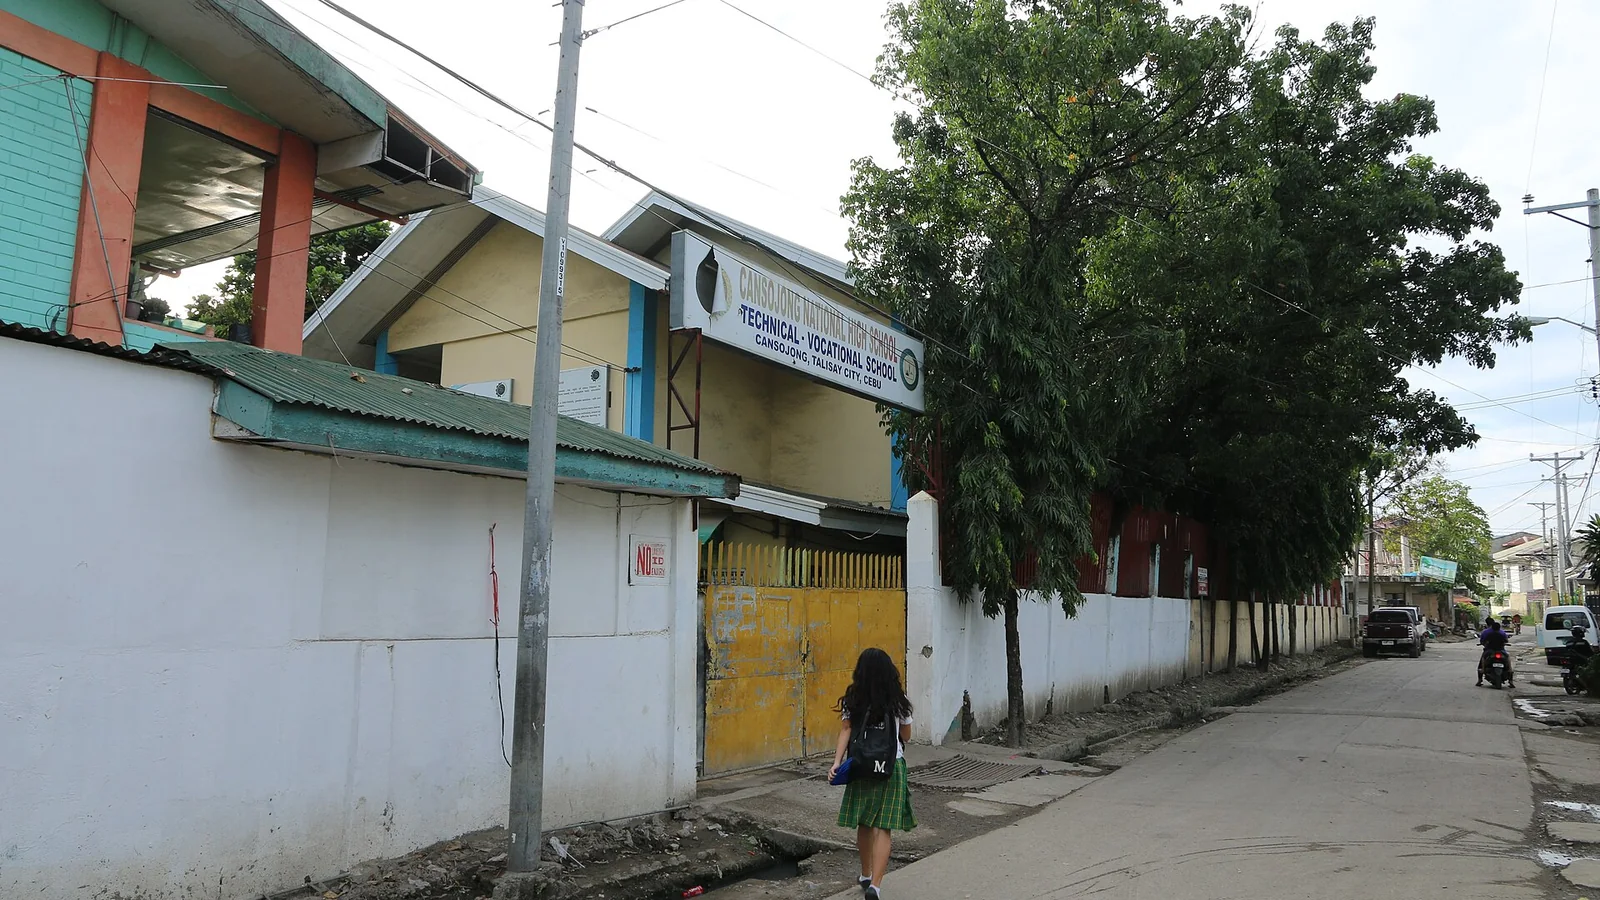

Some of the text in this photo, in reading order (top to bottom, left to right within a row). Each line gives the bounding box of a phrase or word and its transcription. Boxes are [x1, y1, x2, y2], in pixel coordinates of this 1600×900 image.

[739, 266, 898, 363] CANSOJONG NATIONAL HIGH SCHOOL
[740, 304, 800, 345] TECHNICAL
[807, 331, 863, 369] VOCATIONAL
[865, 355, 897, 382] SCHOOL
[755, 333, 882, 390] CANSOJONG, TALISAY CITY, CEBU
[636, 546, 651, 576] NO
[652, 556, 664, 565] ID
[873, 760, 886, 773] M
